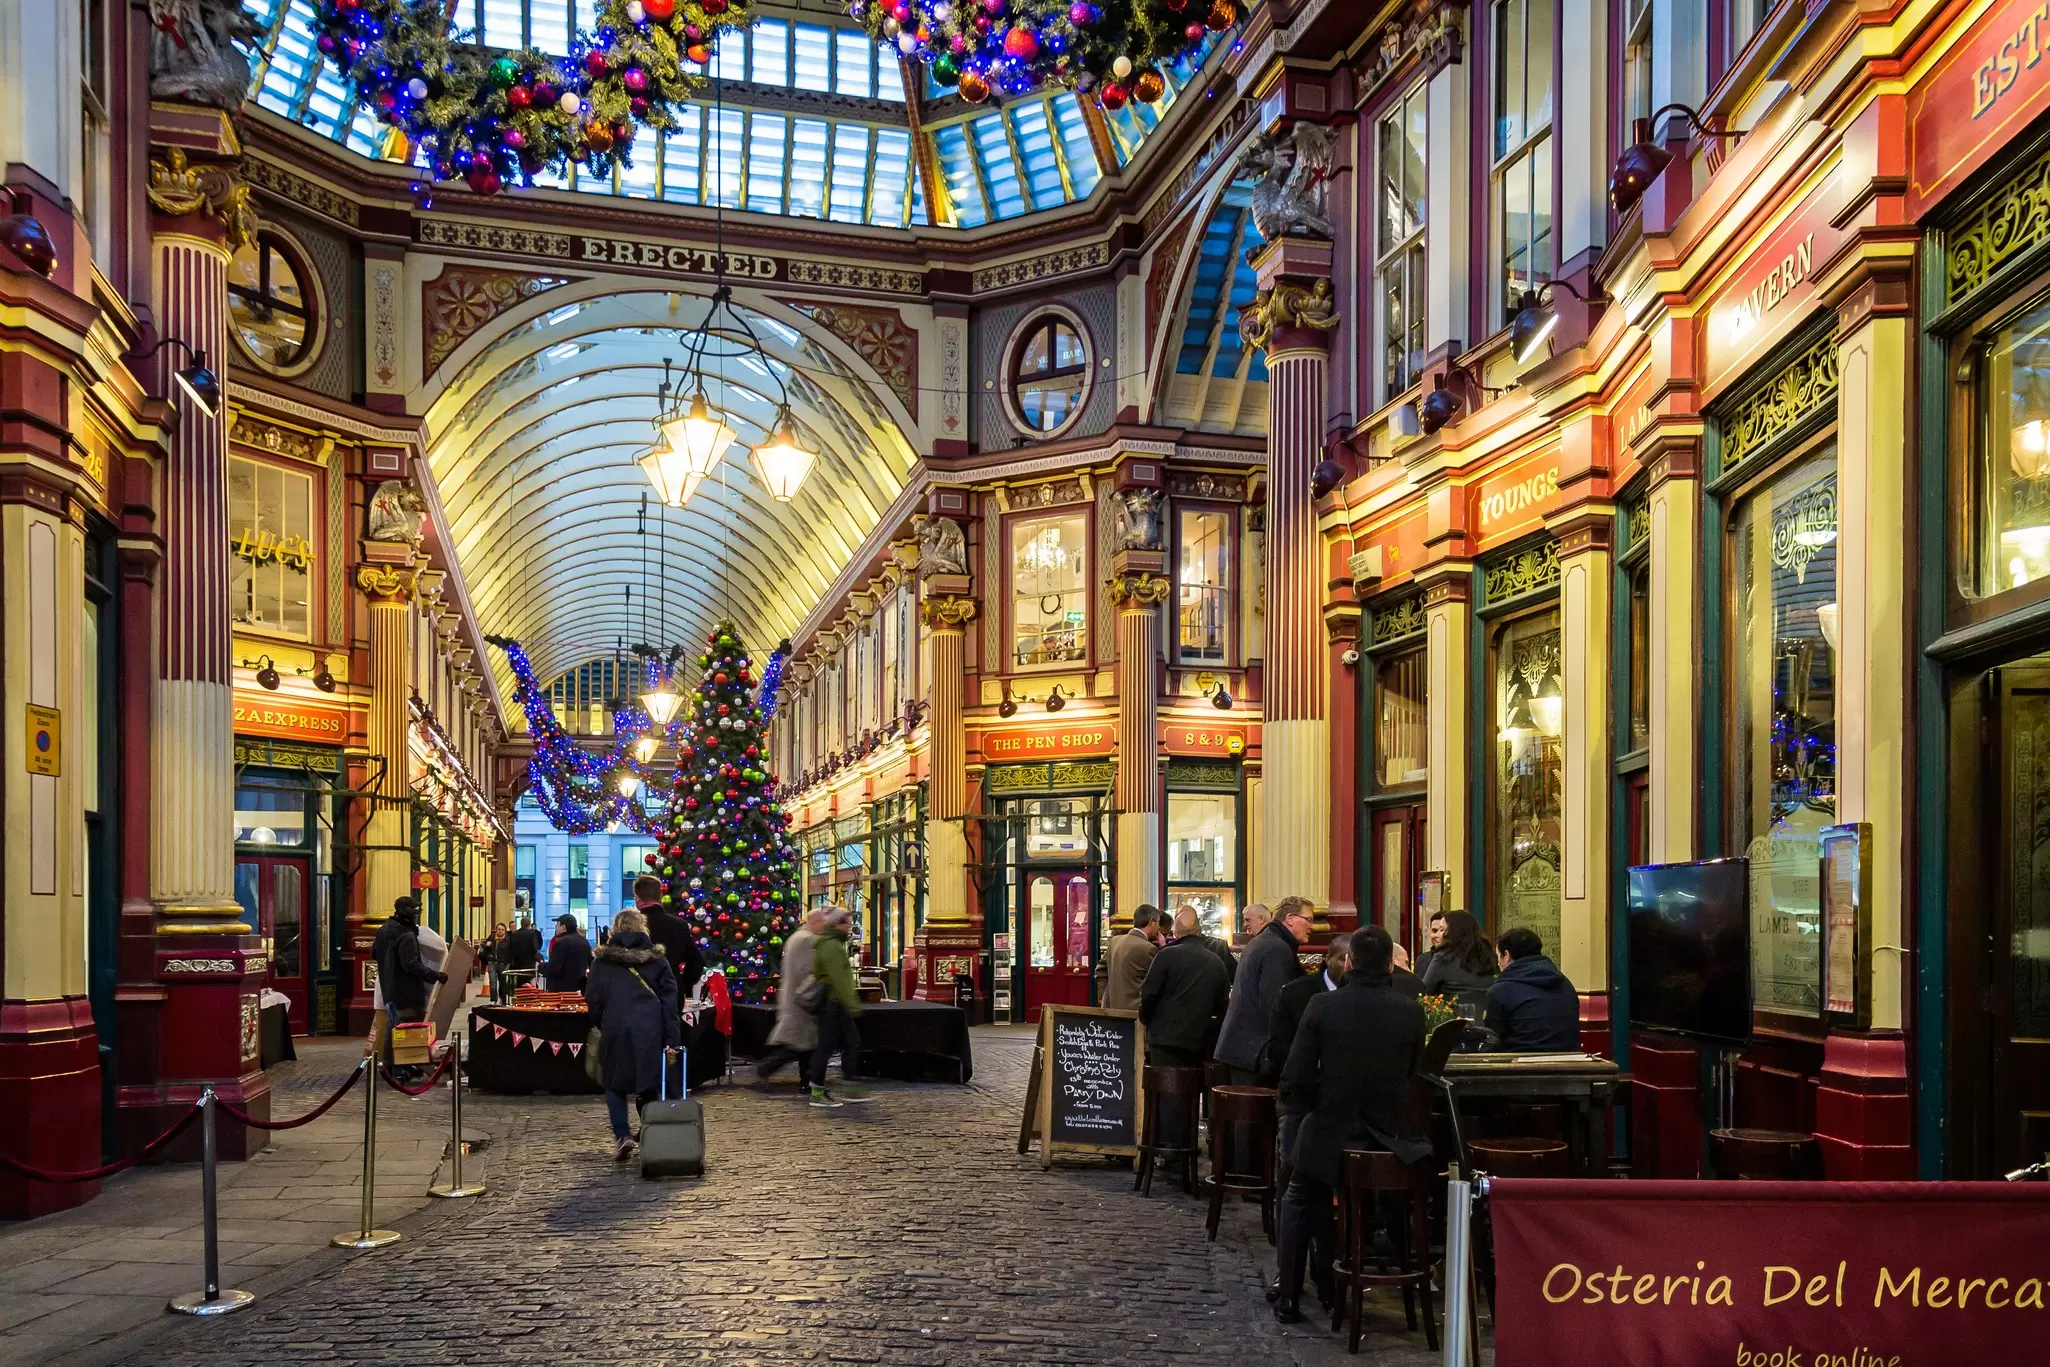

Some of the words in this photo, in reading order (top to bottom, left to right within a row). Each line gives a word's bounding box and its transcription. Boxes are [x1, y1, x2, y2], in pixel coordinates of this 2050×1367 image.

[581, 237, 777, 279] ERECTED
[1063, 349, 1081, 360] BAR
[88, 449, 103, 483] 26
[1479, 466, 1559, 526] YOUNGS
[238, 528, 309, 567] LUC'S
[993, 738, 1021, 751] THE
[1026, 736, 1056, 749] PEN
[1062, 733, 1103, 747] SHOP
[1185, 732, 1195, 745] 8
[1199, 733, 1212, 746] &
[1215, 734, 1224, 746] 9
[1759, 914, 1789, 934] LAMB
[1542, 1261, 1733, 1306] Osteria
[1763, 1261, 1846, 1307] Del
[1874, 1266, 2050, 1309] Merca
[1736, 1342, 1801, 1367] book
[1815, 1347, 1901, 1367] online
